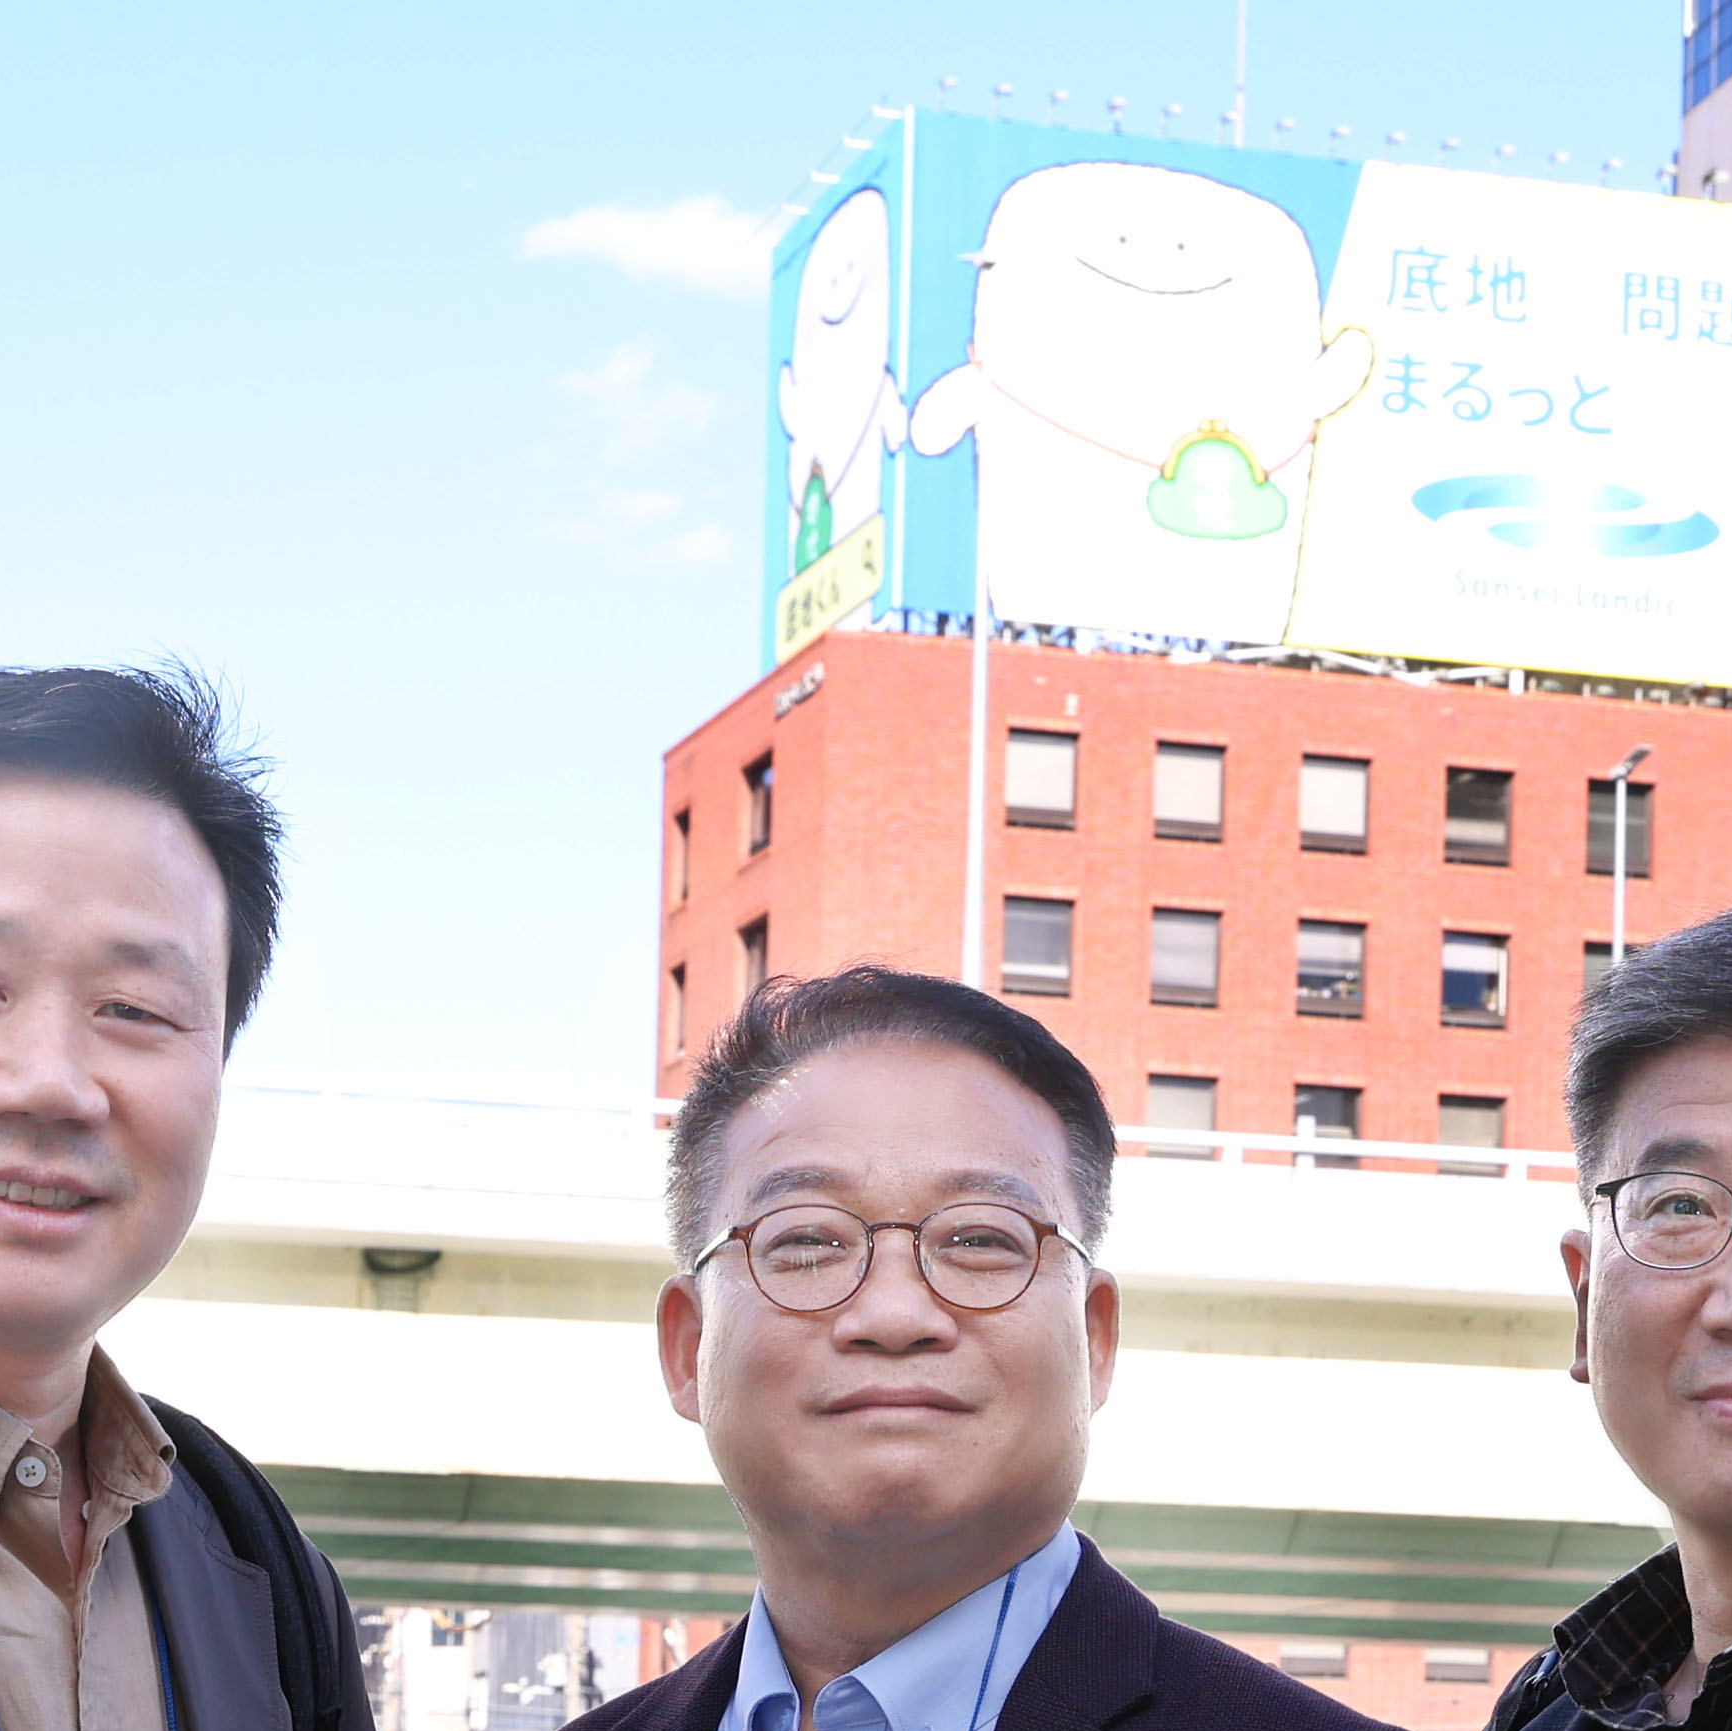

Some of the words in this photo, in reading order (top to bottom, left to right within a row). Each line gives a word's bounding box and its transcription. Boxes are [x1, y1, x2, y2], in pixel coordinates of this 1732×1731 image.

[1386, 245, 1528, 324] 底地
[1381, 352, 1613, 435] まるっと
